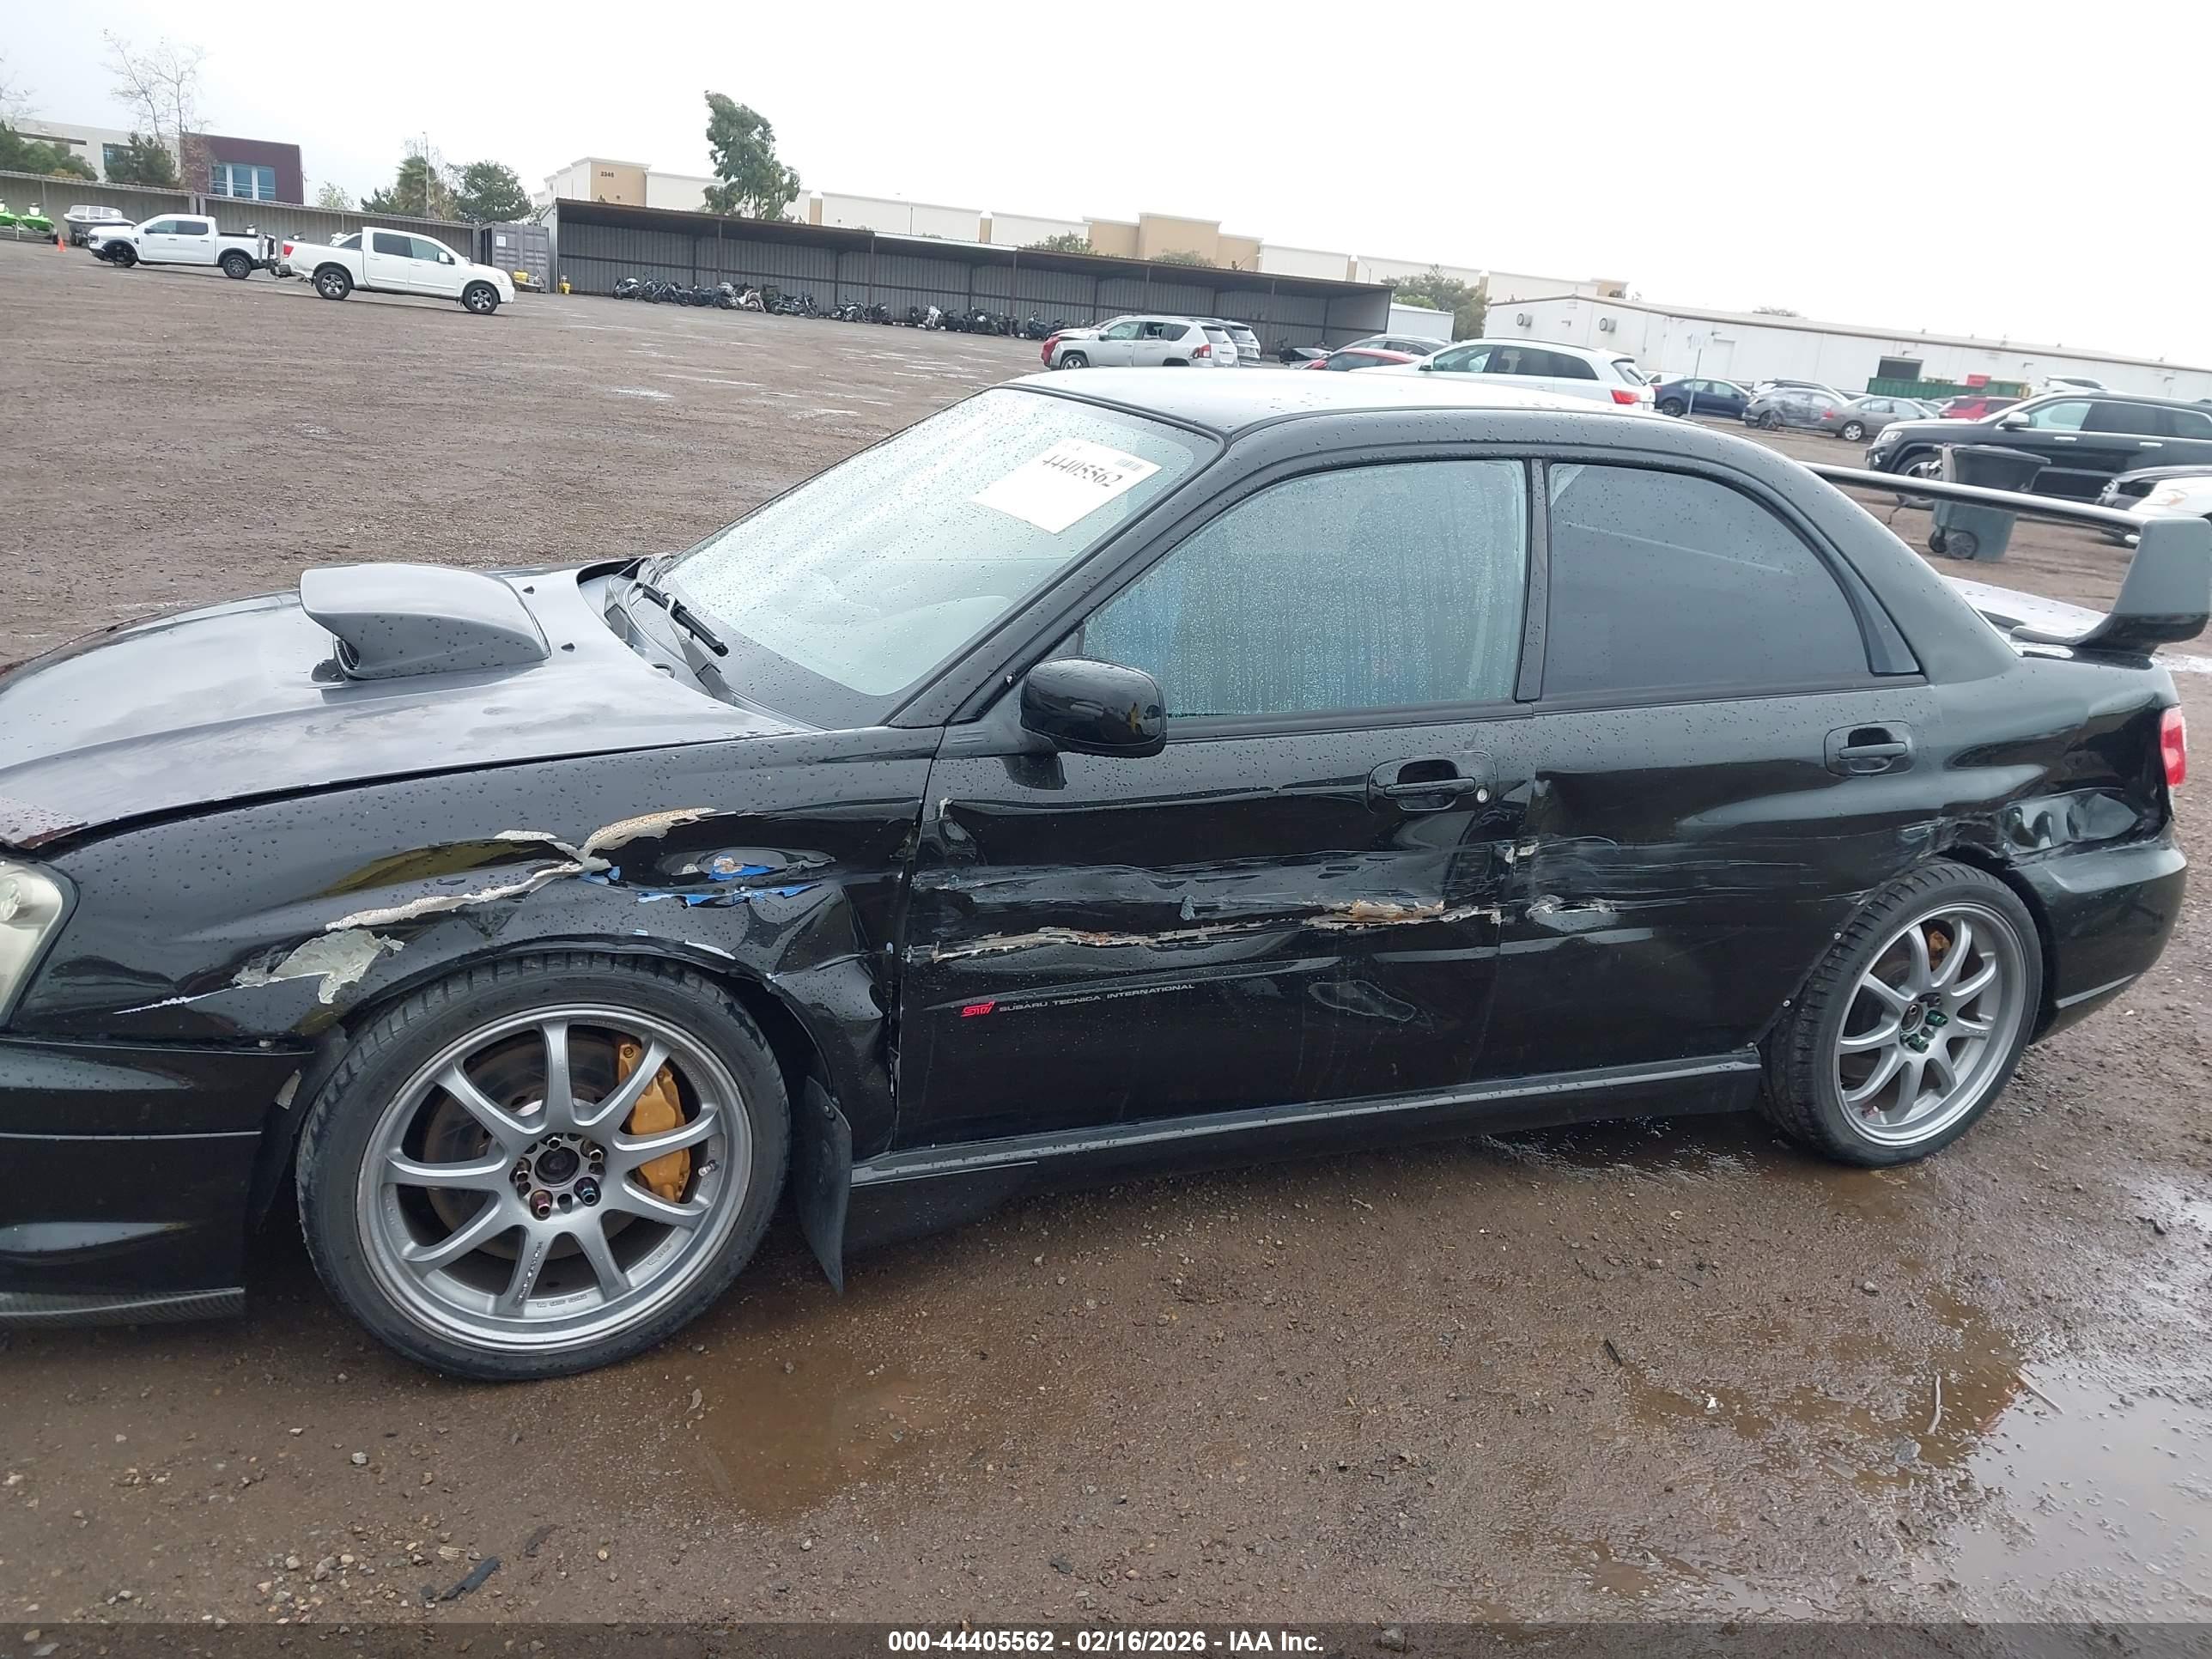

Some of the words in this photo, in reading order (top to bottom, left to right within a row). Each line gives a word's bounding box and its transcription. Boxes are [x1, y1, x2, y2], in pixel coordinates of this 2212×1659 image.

[1042, 453, 1123, 487] 44405562
[999, 1001, 1048, 1012] SUBARU
[1052, 995, 1101, 1006] TECNICA
[1106, 984, 1196, 1000] INTERNATIONAL
